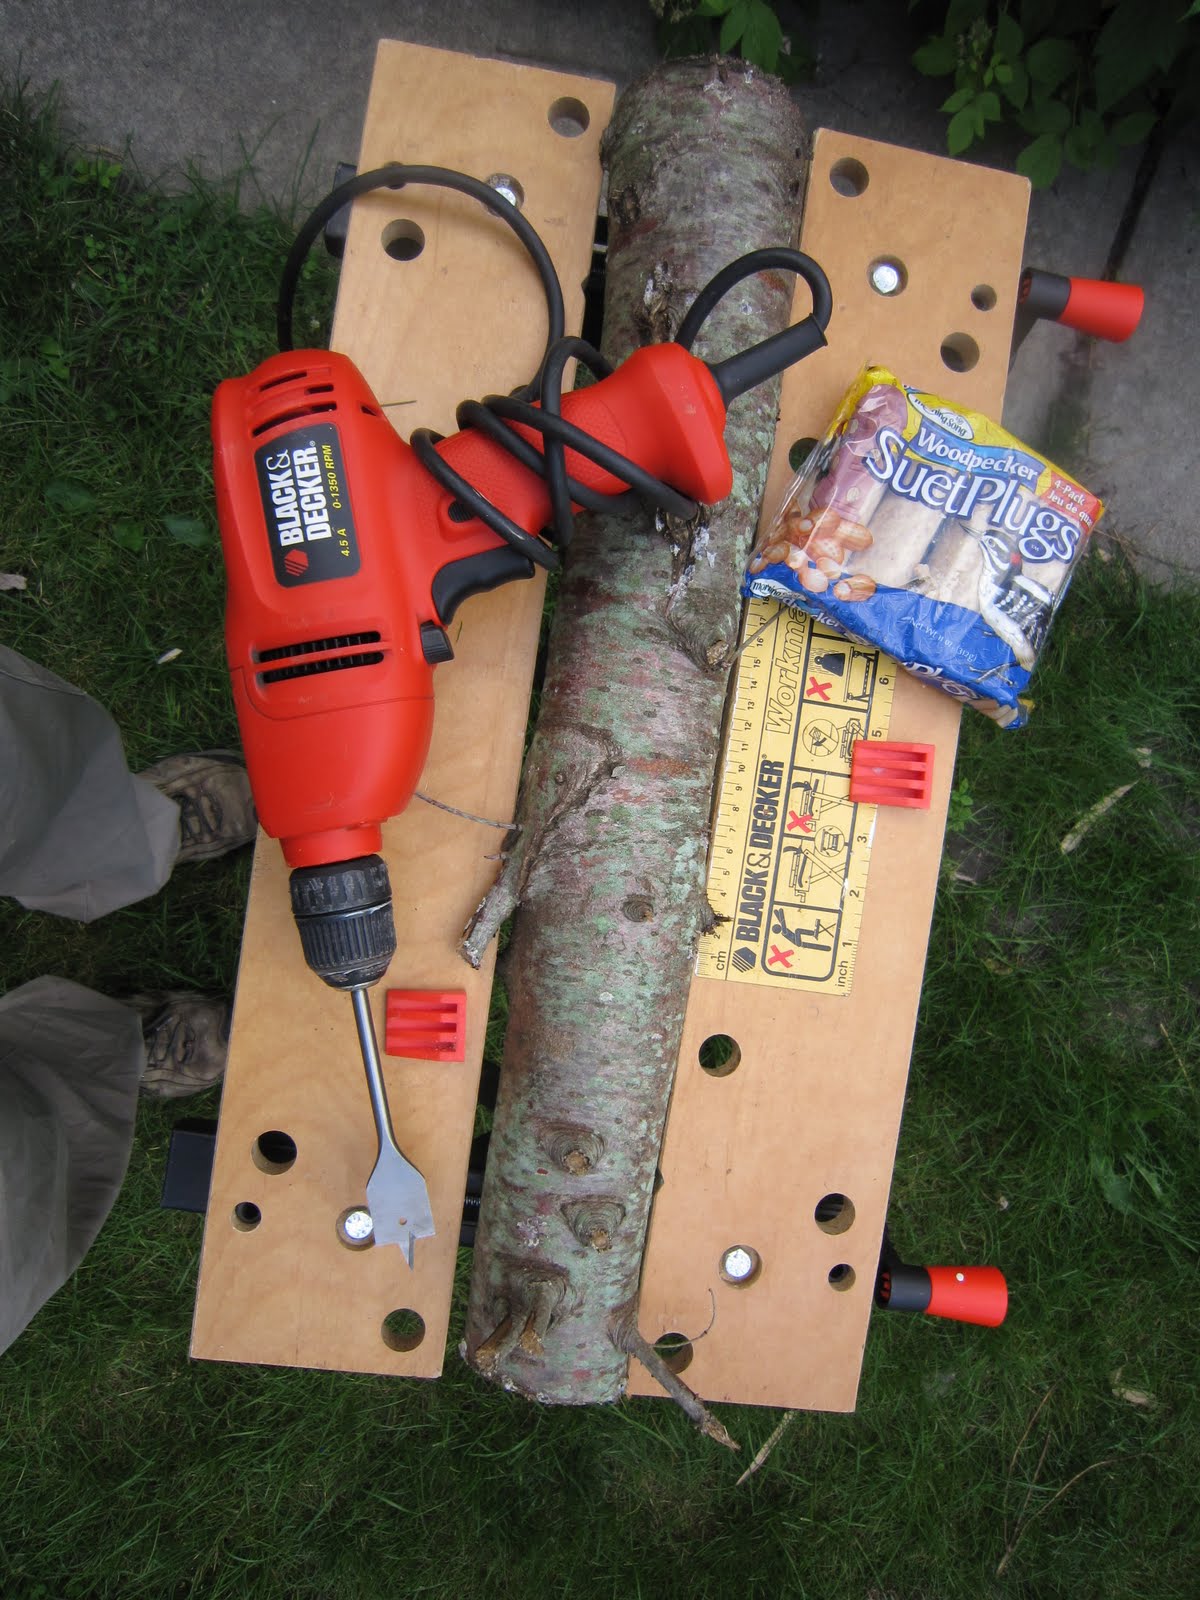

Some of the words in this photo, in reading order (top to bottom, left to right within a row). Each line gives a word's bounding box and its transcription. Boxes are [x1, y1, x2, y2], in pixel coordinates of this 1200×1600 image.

[946, 414, 968, 438] Song
[321, 444, 335, 470] RPM
[917, 427, 1039, 481] Woodpecker
[328, 472, 342, 509] 0-1350
[1047, 488, 1065, 509] Jeu
[1065, 501, 1077, 514] de
[1053, 479, 1086, 506] 4-Pack
[336, 528, 347, 537] A
[339, 539, 350, 557] 4.5
[756, 637, 764, 647] 16
[909, 616, 924, 630] Net
[925, 628, 937, 640] Wt
[955, 645, 978, 663] (312g)
[753, 659, 761, 668] 15
[750, 680, 758, 689] 14
[747, 700, 755, 710] 13
[744, 721, 752, 731] 12
[741, 742, 749, 751] 11
[738, 764, 746, 773] 10
[842, 940, 852, 948] 1
[849, 889, 860, 898] 2
[857, 835, 867, 843] 3
[871, 729, 882, 738] 5
[878, 677, 889, 686] 6
[716, 950, 727, 971] cm
[835, 960, 849, 988] inch
